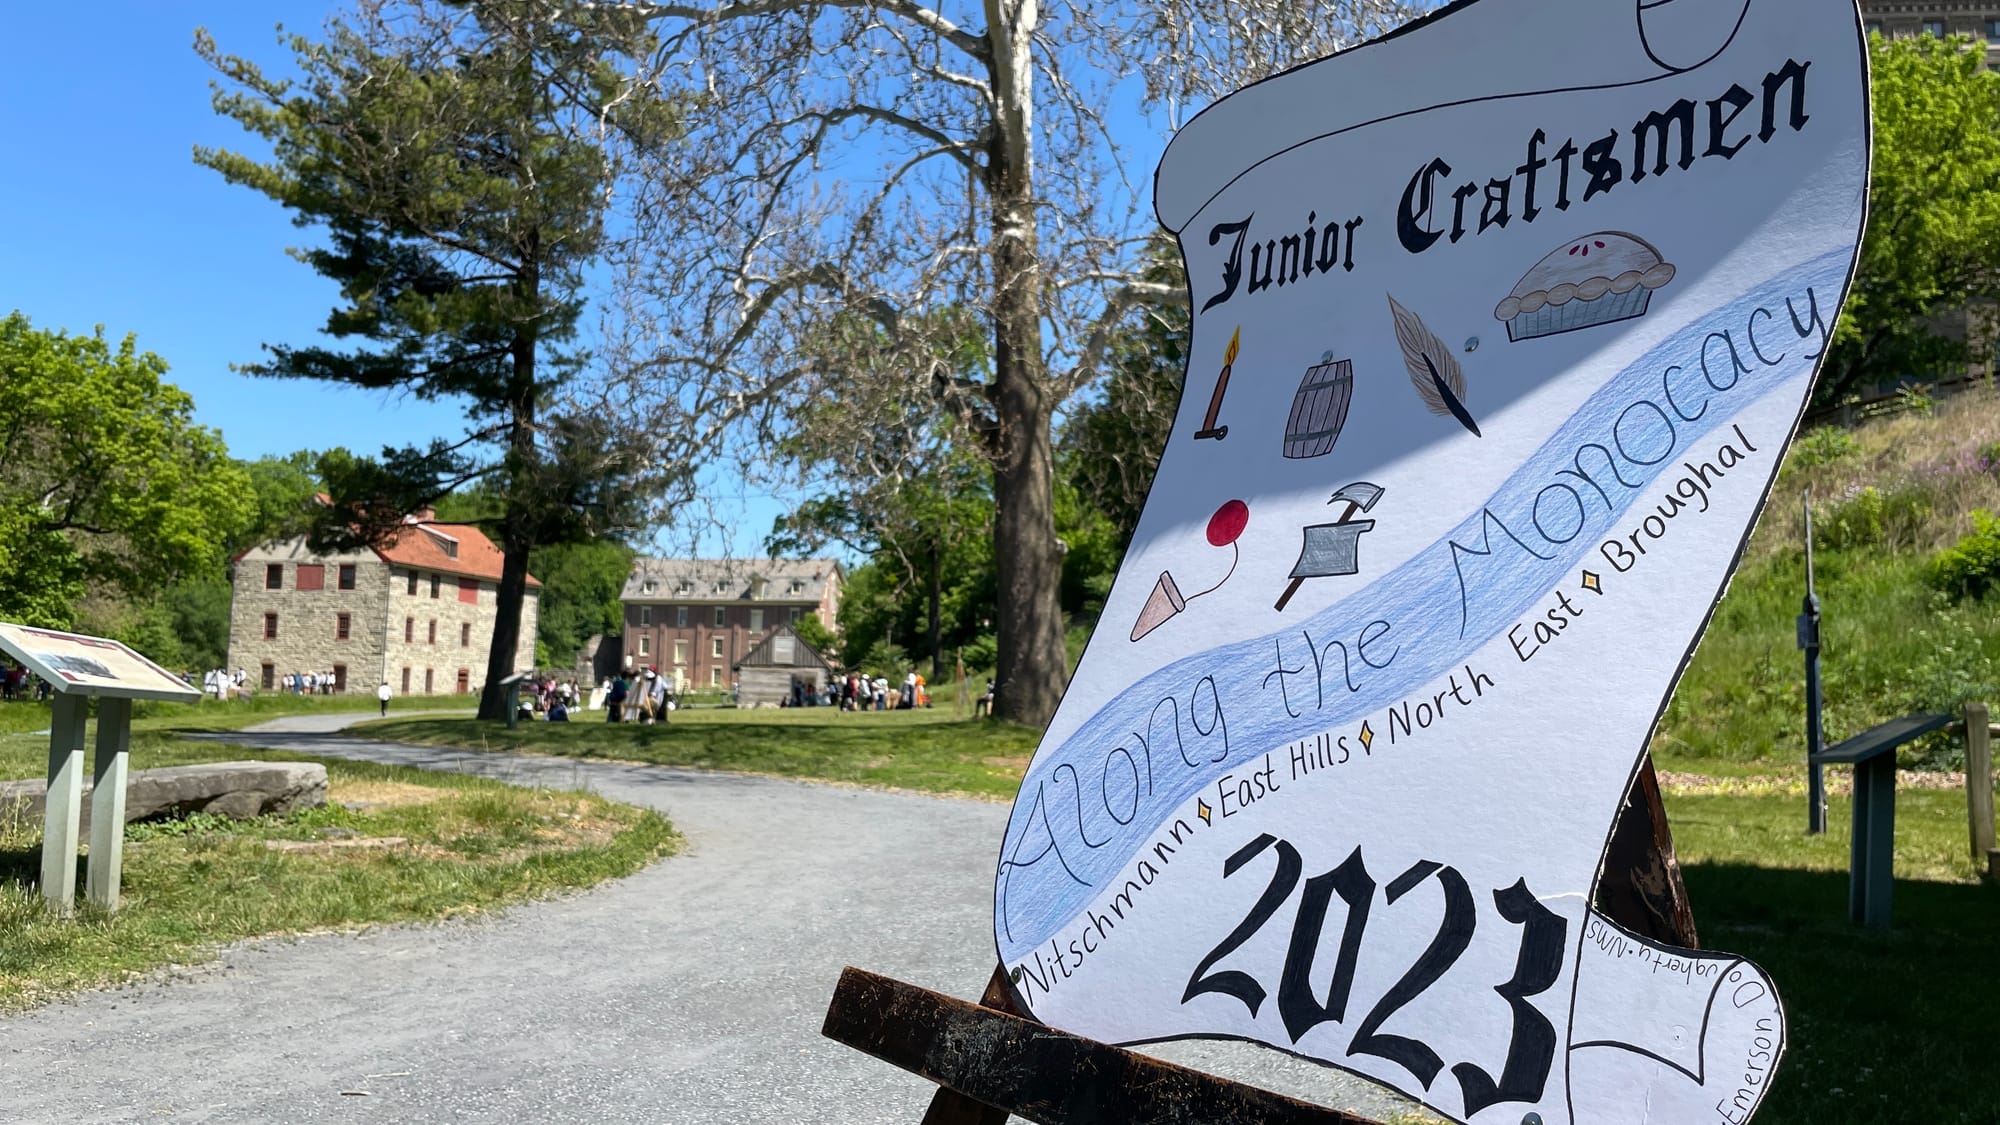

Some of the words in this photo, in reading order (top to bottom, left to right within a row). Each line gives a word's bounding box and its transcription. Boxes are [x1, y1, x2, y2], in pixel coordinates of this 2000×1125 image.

[1201, 211, 1364, 315] Junior
[1397, 58, 1811, 254] Craftsmen
[999, 674, 1229, 943] Along
[1262, 619, 1400, 719] the
[1449, 287, 1827, 641] Monocacy
[1018, 818, 1194, 1008] Nitschmann
[1217, 753, 1281, 818] East
[1289, 733, 1350, 781] Hills
[1388, 665, 1495, 744] North
[1507, 590, 1583, 662] East
[1600, 424, 1758, 573] Broughal
[1180, 833, 1568, 1120] 2023
[1715, 1017, 1773, 1125] Emerson
